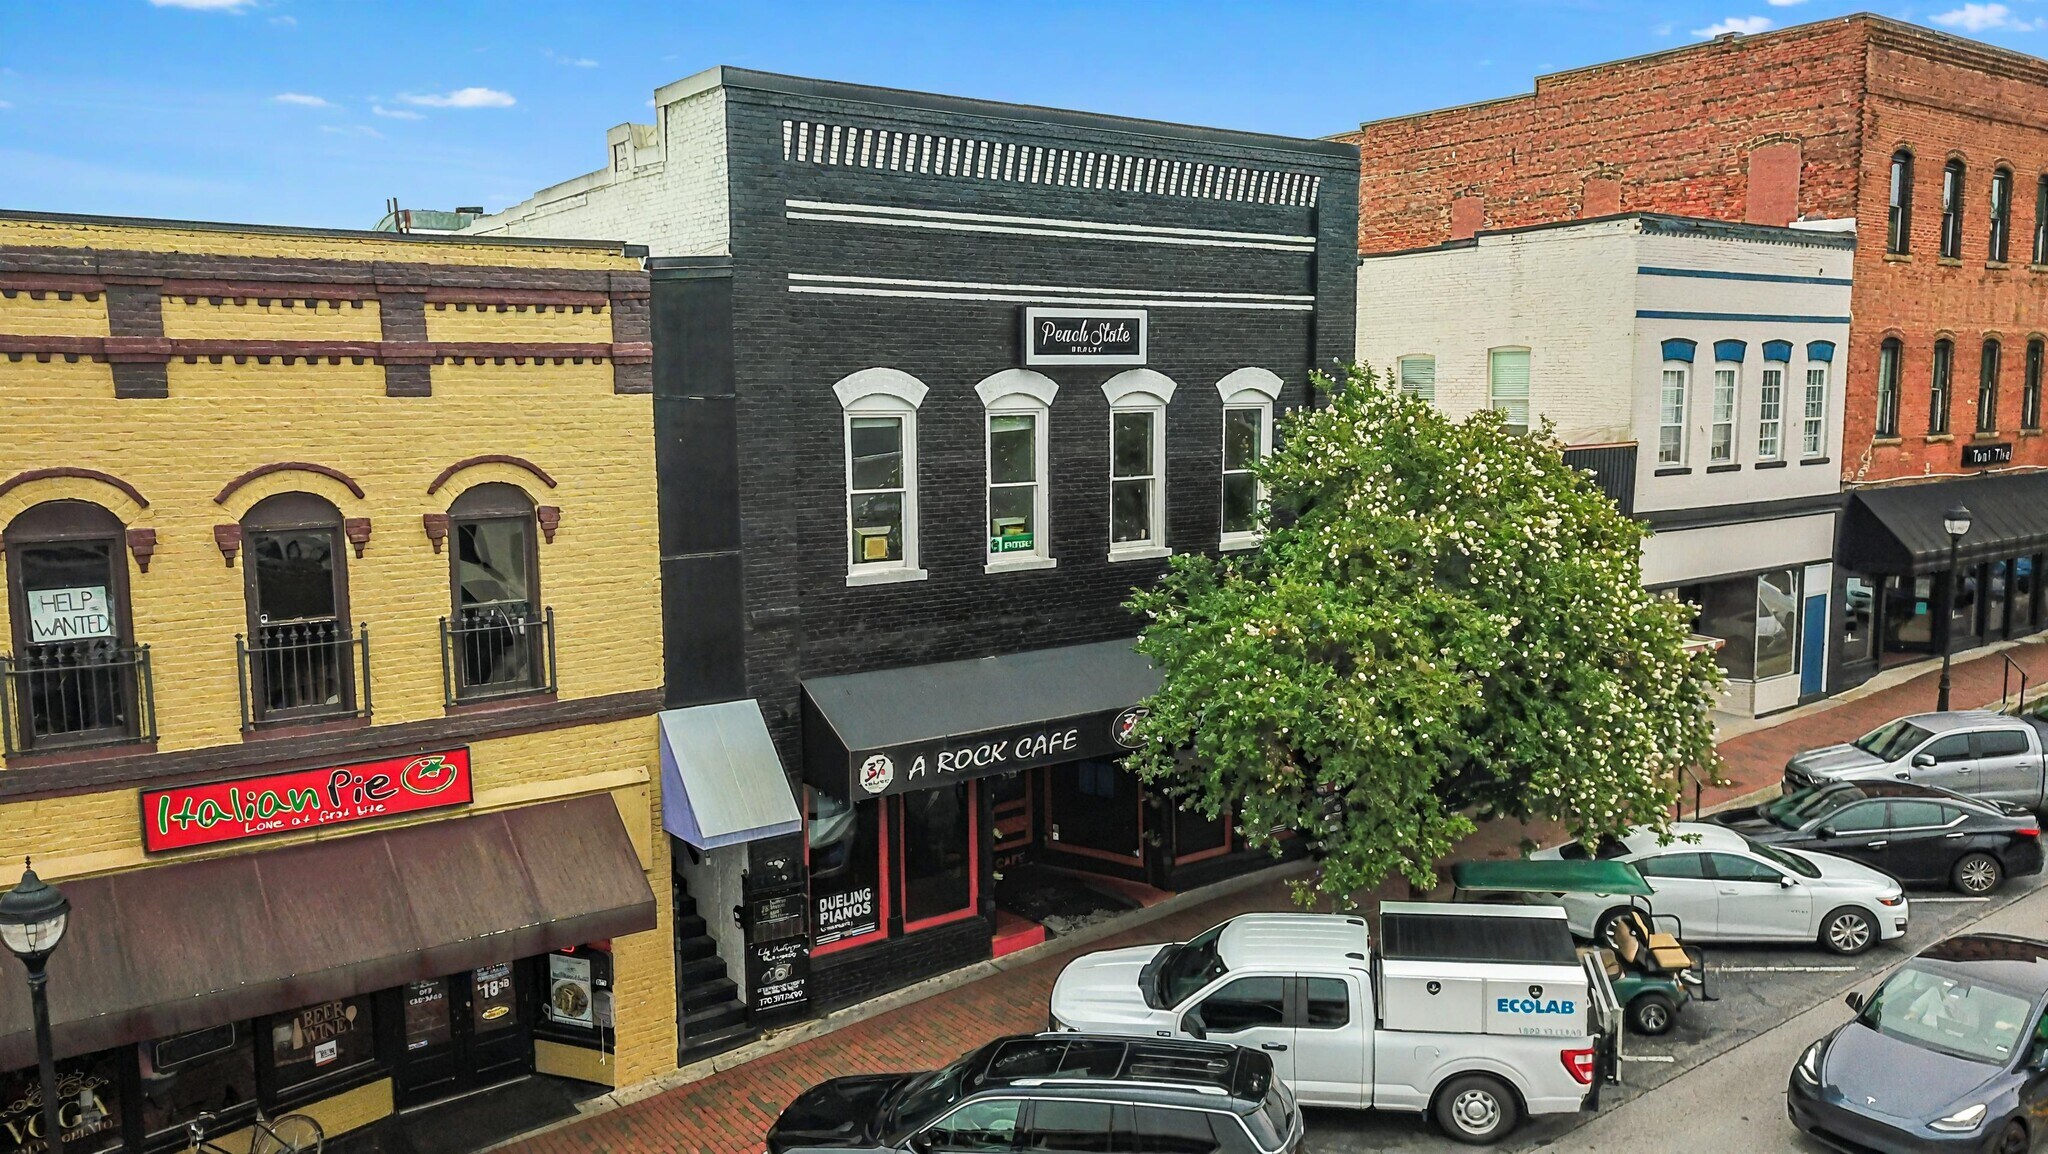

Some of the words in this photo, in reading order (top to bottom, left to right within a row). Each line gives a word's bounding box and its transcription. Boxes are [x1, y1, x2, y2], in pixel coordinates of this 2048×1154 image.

[1041, 319, 1089, 346] Peach
[1090, 320, 1131, 346] State
[40, 591, 93, 613] HELP
[34, 614, 110, 637] WANTED
[908, 752, 926, 782] A
[937, 740, 1008, 775] ROCK
[1014, 728, 1078, 759] CAFE
[156, 787, 319, 835] Italian
[326, 768, 400, 807] Pie
[819, 887, 872, 913] DUELING
[819, 901, 872, 926] PIANOS
[303, 1001, 346, 1028] BEER
[1497, 998, 1575, 1015] ECOLAB
[302, 1016, 347, 1043] WINE
